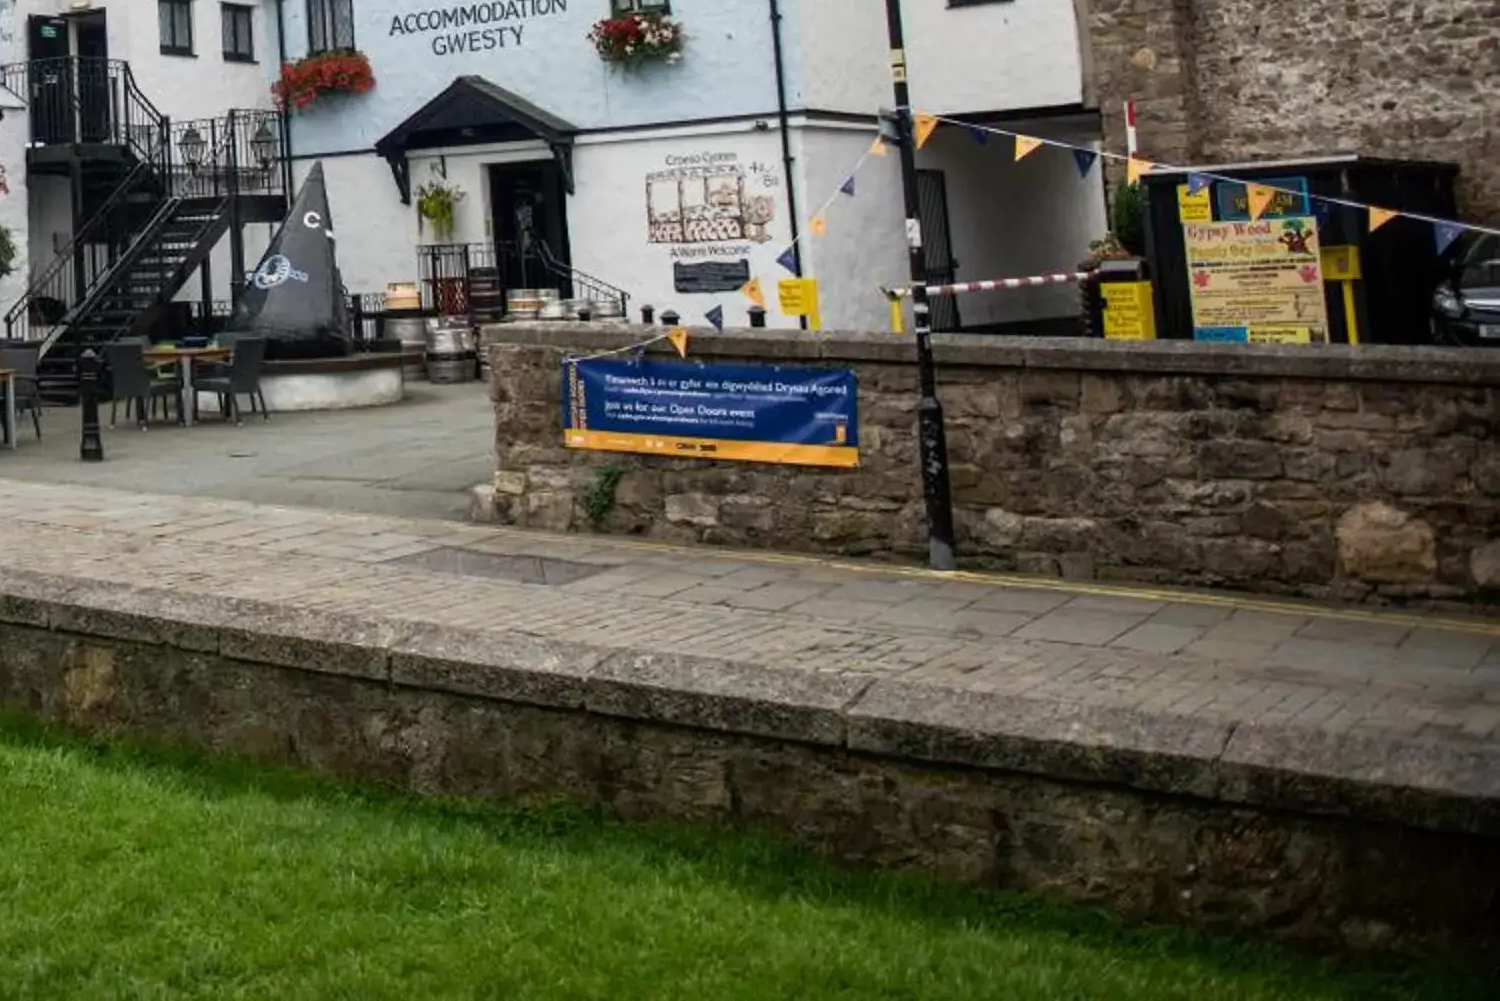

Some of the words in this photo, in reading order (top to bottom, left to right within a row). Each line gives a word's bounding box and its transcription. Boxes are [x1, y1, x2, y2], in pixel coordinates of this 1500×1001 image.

[431, 24, 524, 56] GWESTY
[1187, 224, 1228, 242] Gypsy
[1234, 222, 1271, 236] Wood
[669, 403, 695, 415] Open
